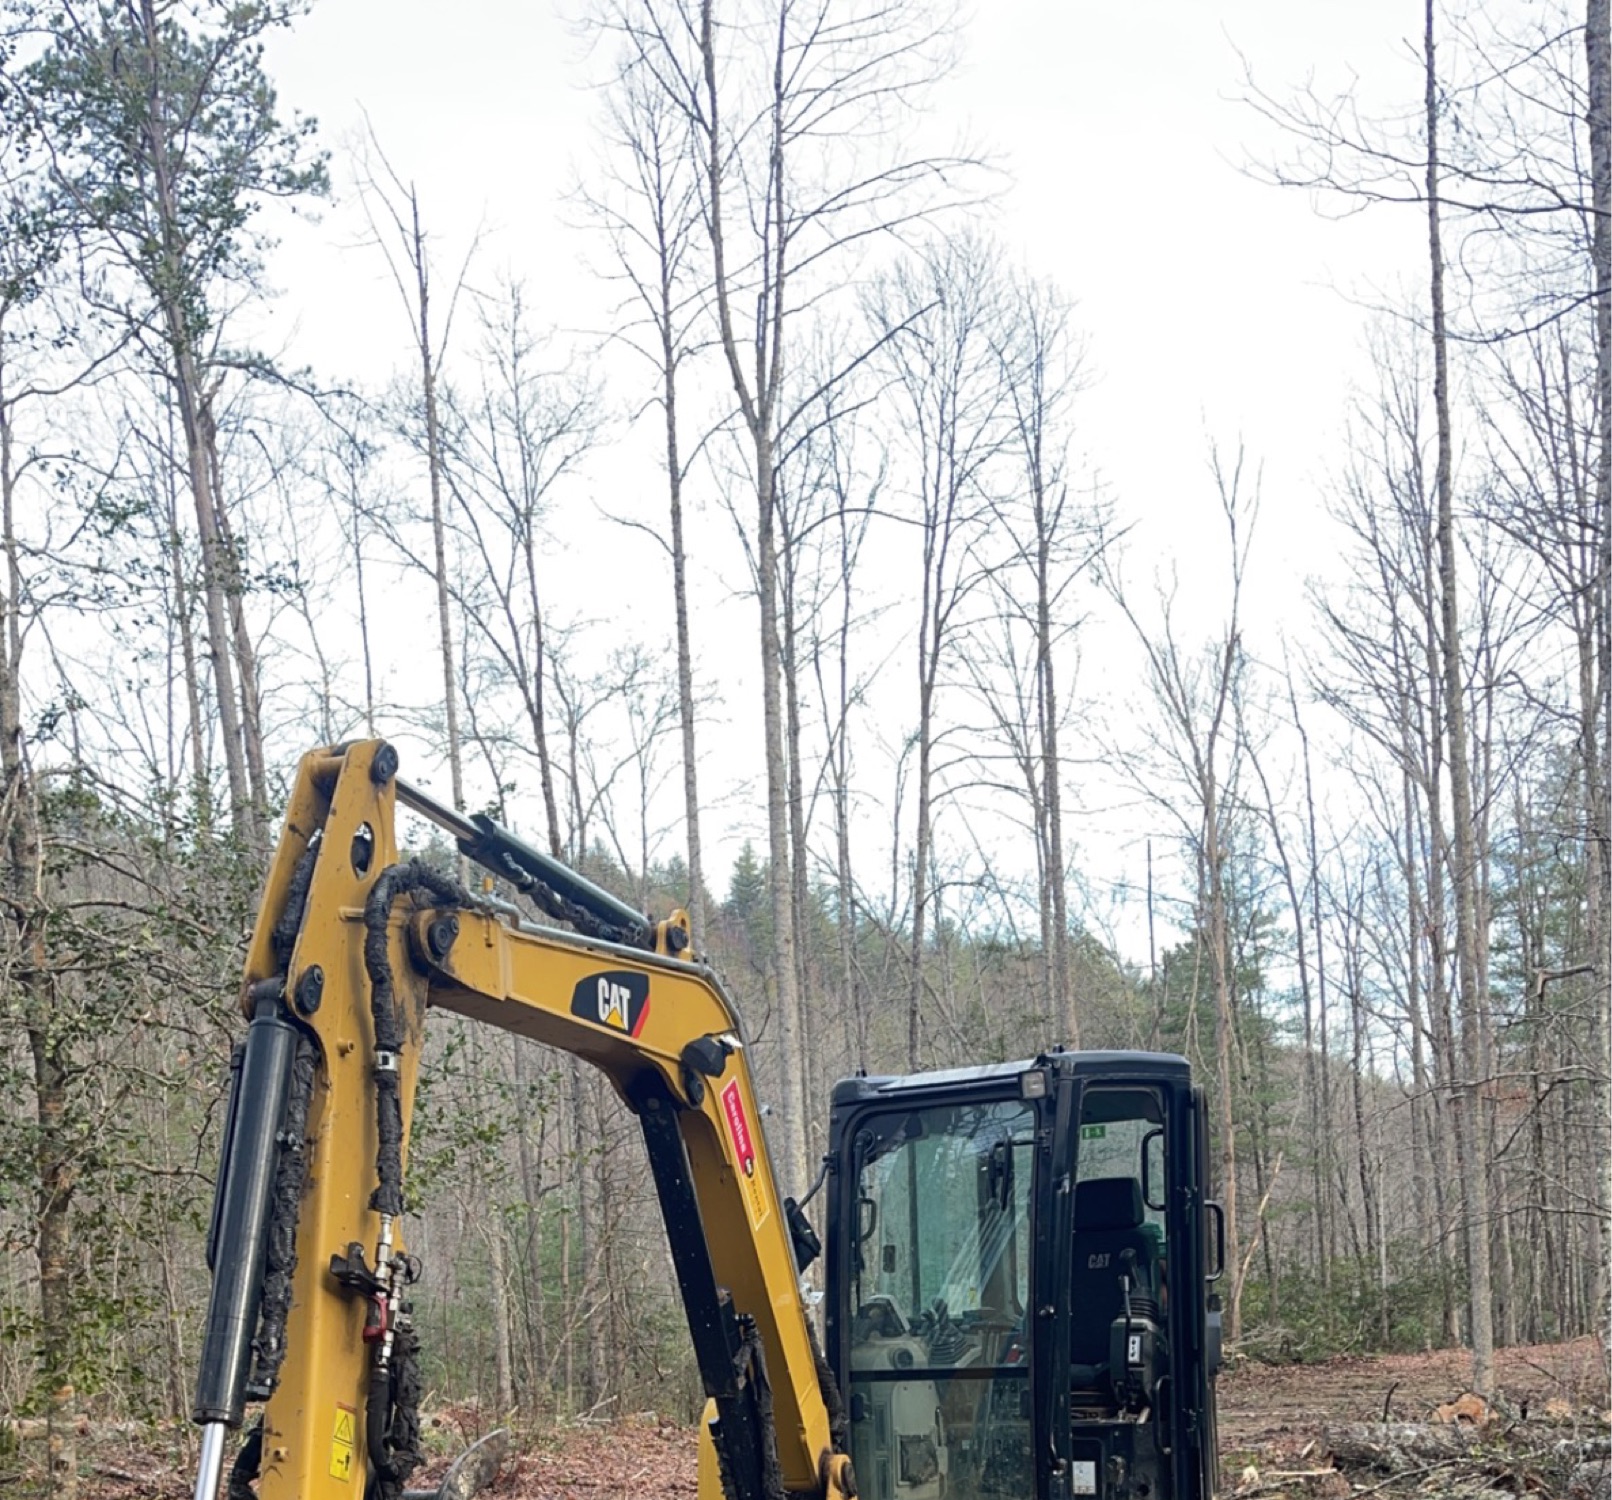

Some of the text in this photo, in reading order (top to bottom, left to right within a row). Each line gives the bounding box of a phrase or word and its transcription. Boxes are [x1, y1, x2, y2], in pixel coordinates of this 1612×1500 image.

[598, 977, 631, 1030] CAT
[727, 1090, 747, 1153] Carolina
[1088, 1253, 1110, 1269] CAT
